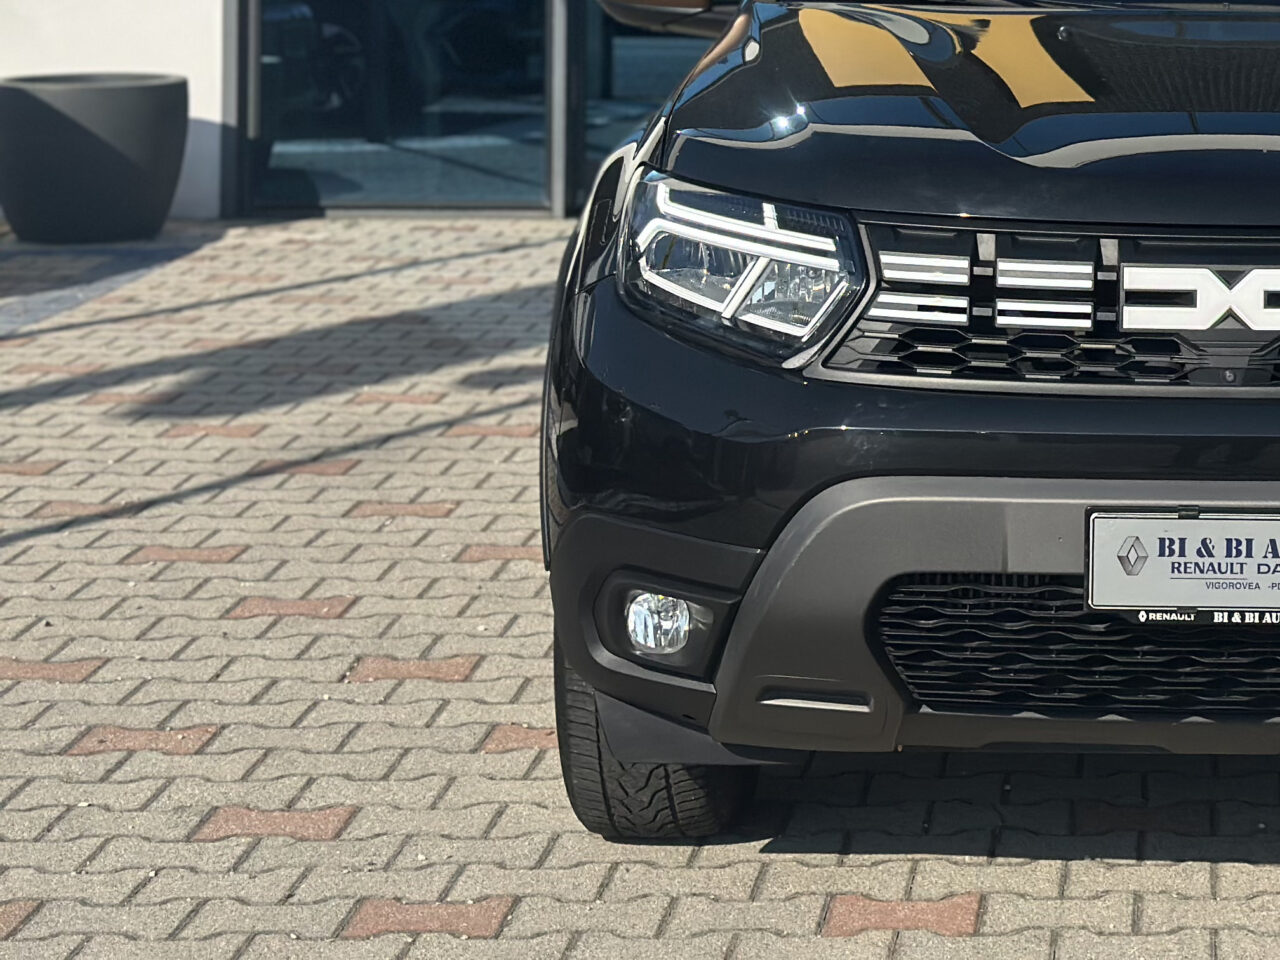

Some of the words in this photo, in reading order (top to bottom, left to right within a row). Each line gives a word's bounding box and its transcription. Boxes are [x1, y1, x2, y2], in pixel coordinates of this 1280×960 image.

[1157, 537, 1187, 558] BI
[1196, 537, 1215, 559] &
[1224, 537, 1255, 558] BI
[1171, 561, 1248, 575] RENAULT
[1205, 581, 1261, 590] VIGOROVEA
[1148, 612, 1197, 621] RENAULT
[1213, 611, 1229, 623] BI
[1231, 611, 1242, 623] &
[1245, 612, 1260, 623] BI
